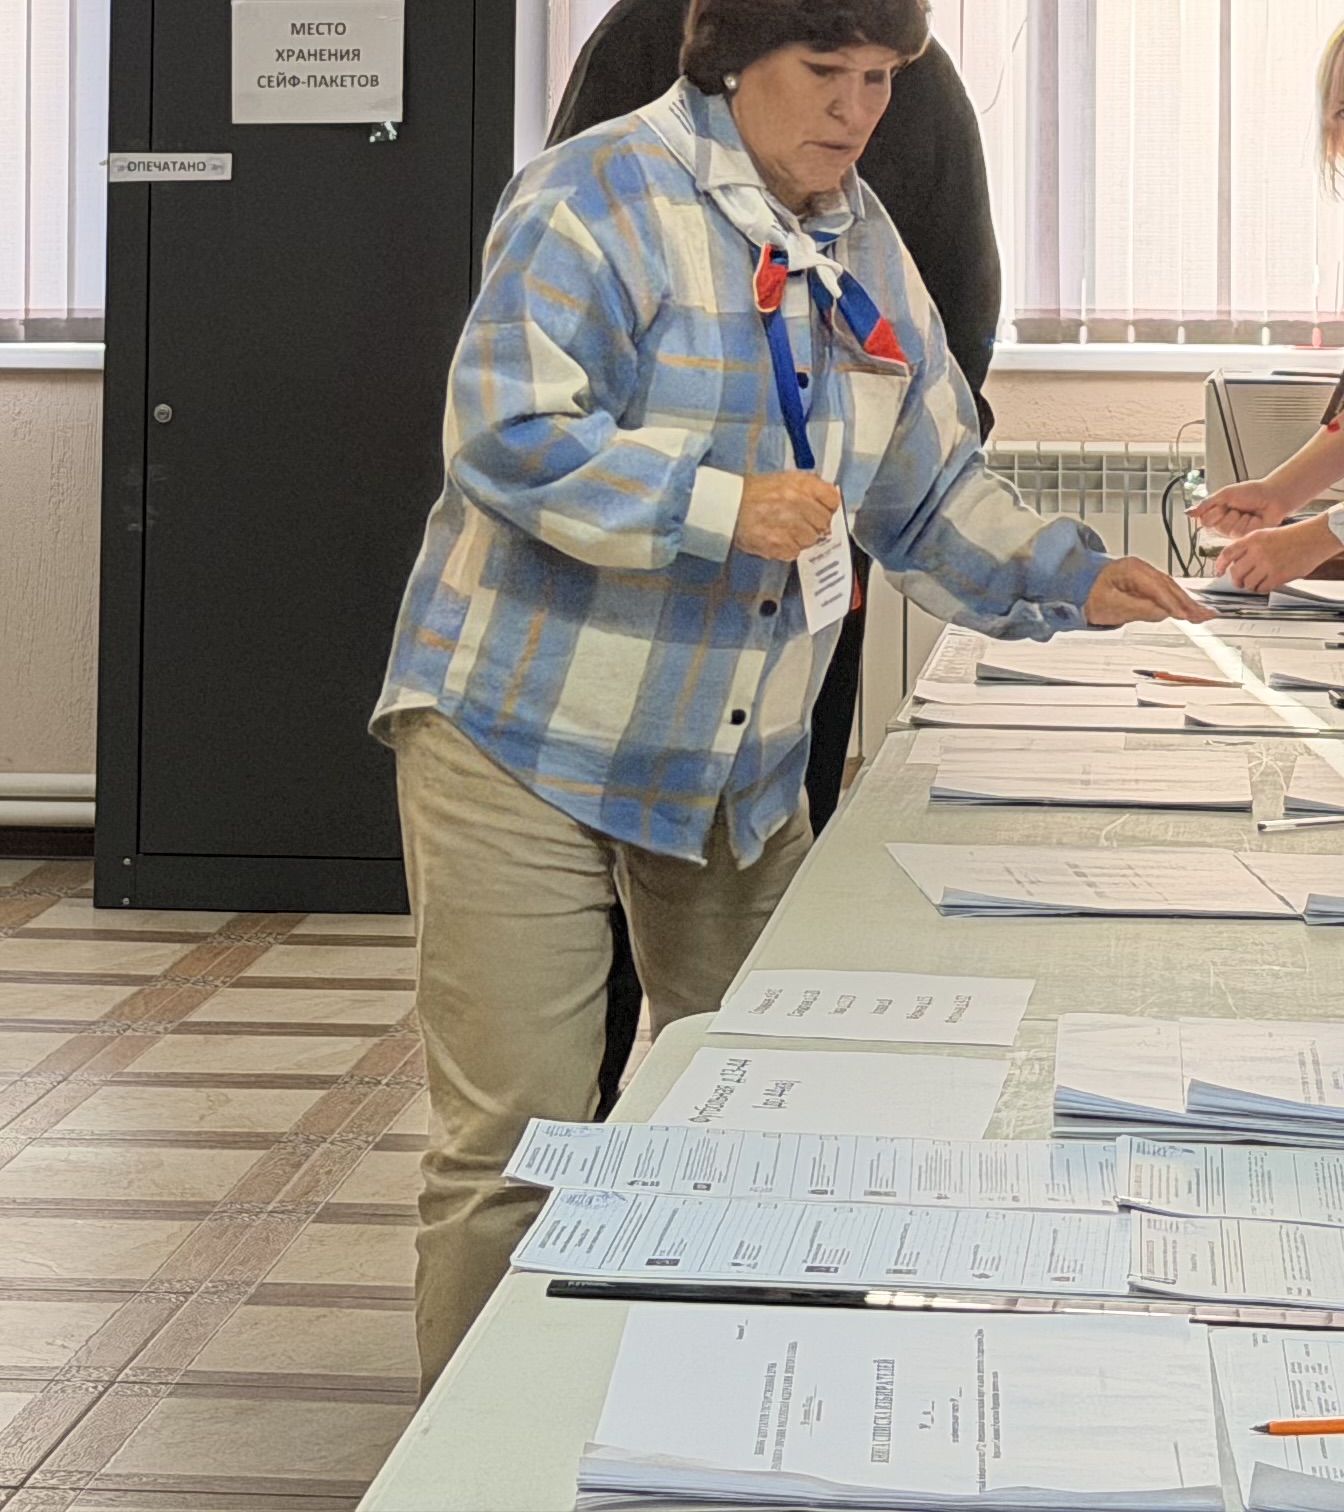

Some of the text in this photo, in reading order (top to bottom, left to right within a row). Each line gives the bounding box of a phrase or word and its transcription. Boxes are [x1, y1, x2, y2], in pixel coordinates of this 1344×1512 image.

[290, 22, 347, 36] МЕСТО
[275, 48, 361, 62] ХРАНЕНИЯ
[256, 72, 380, 88] СЕЙФ-ПАКЕТОВ
[127, 160, 207, 173] ОПЕЧАТАНО
